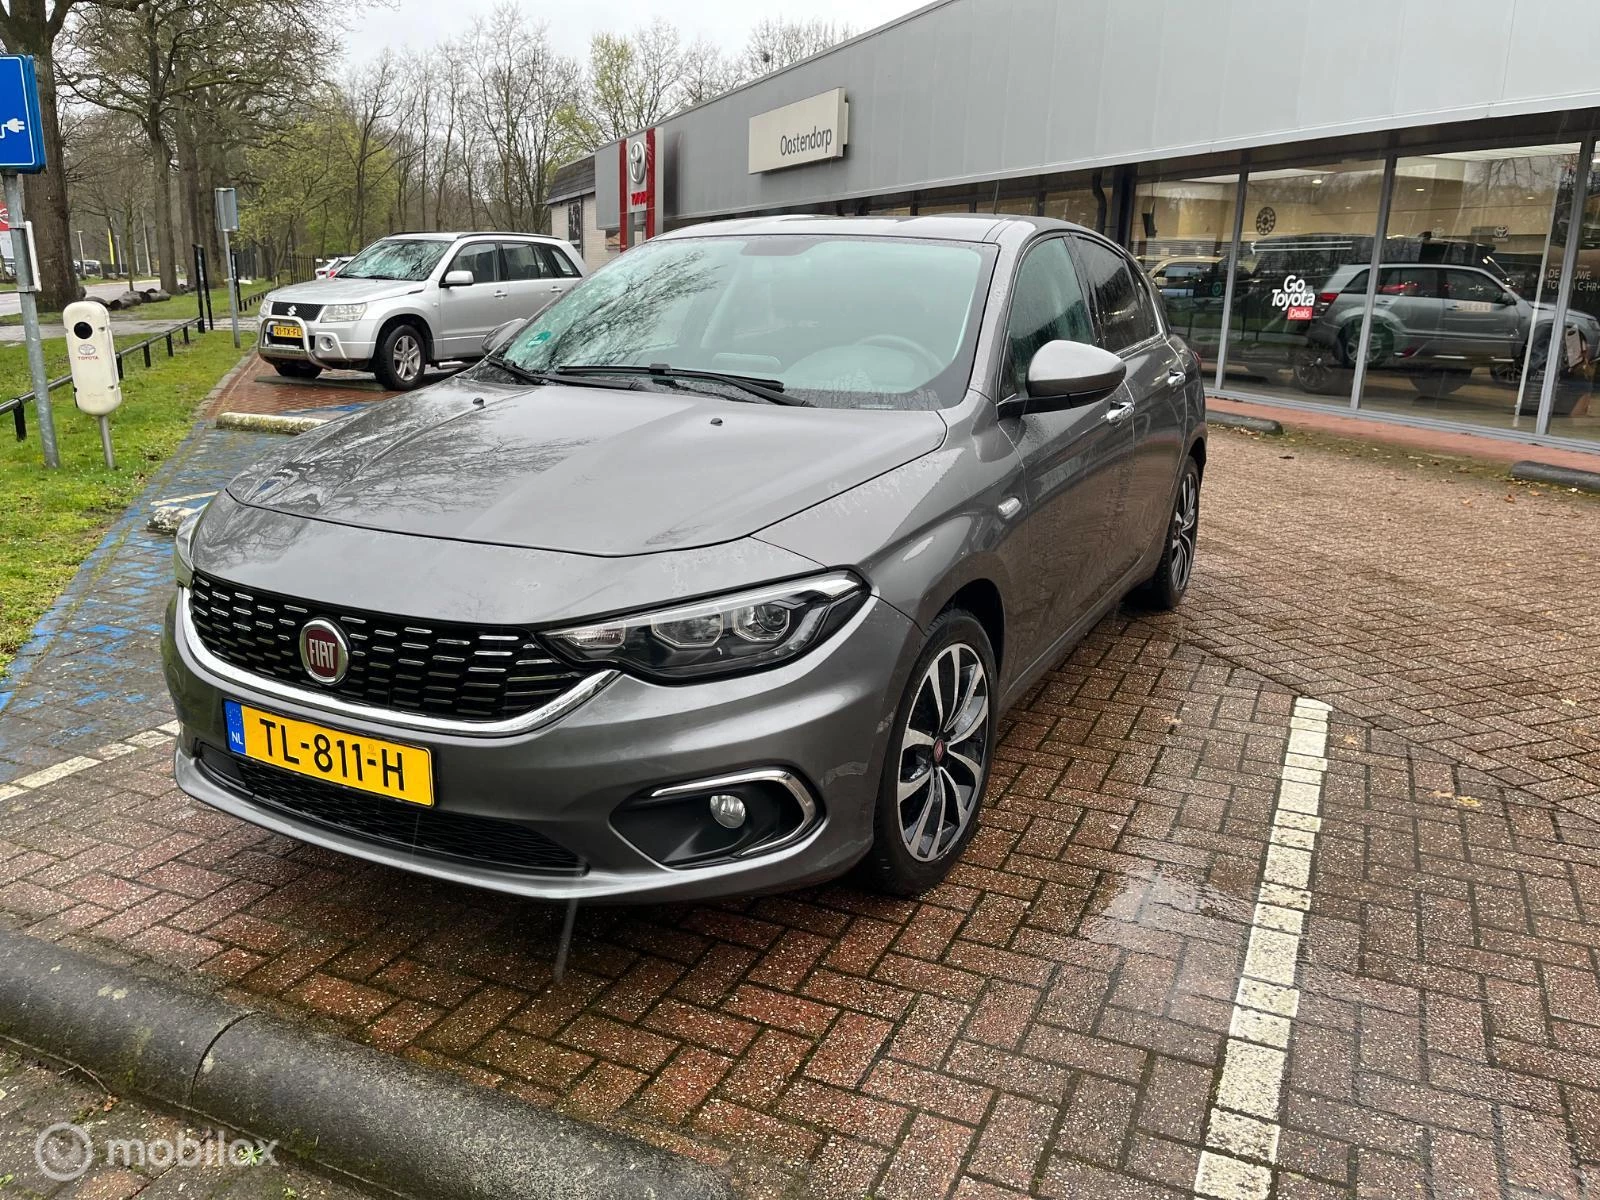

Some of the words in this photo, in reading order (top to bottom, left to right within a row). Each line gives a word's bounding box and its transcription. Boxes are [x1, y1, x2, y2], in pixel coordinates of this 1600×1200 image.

[781, 126, 832, 156] Oostendorp
[1283, 274, 1305, 293] Go
[1271, 288, 1316, 311] Toyota
[1289, 308, 1310, 318] Deals
[308, 638, 335, 669] FIAT
[231, 730, 243, 745] NL
[259, 718, 405, 791] TL-811-H
